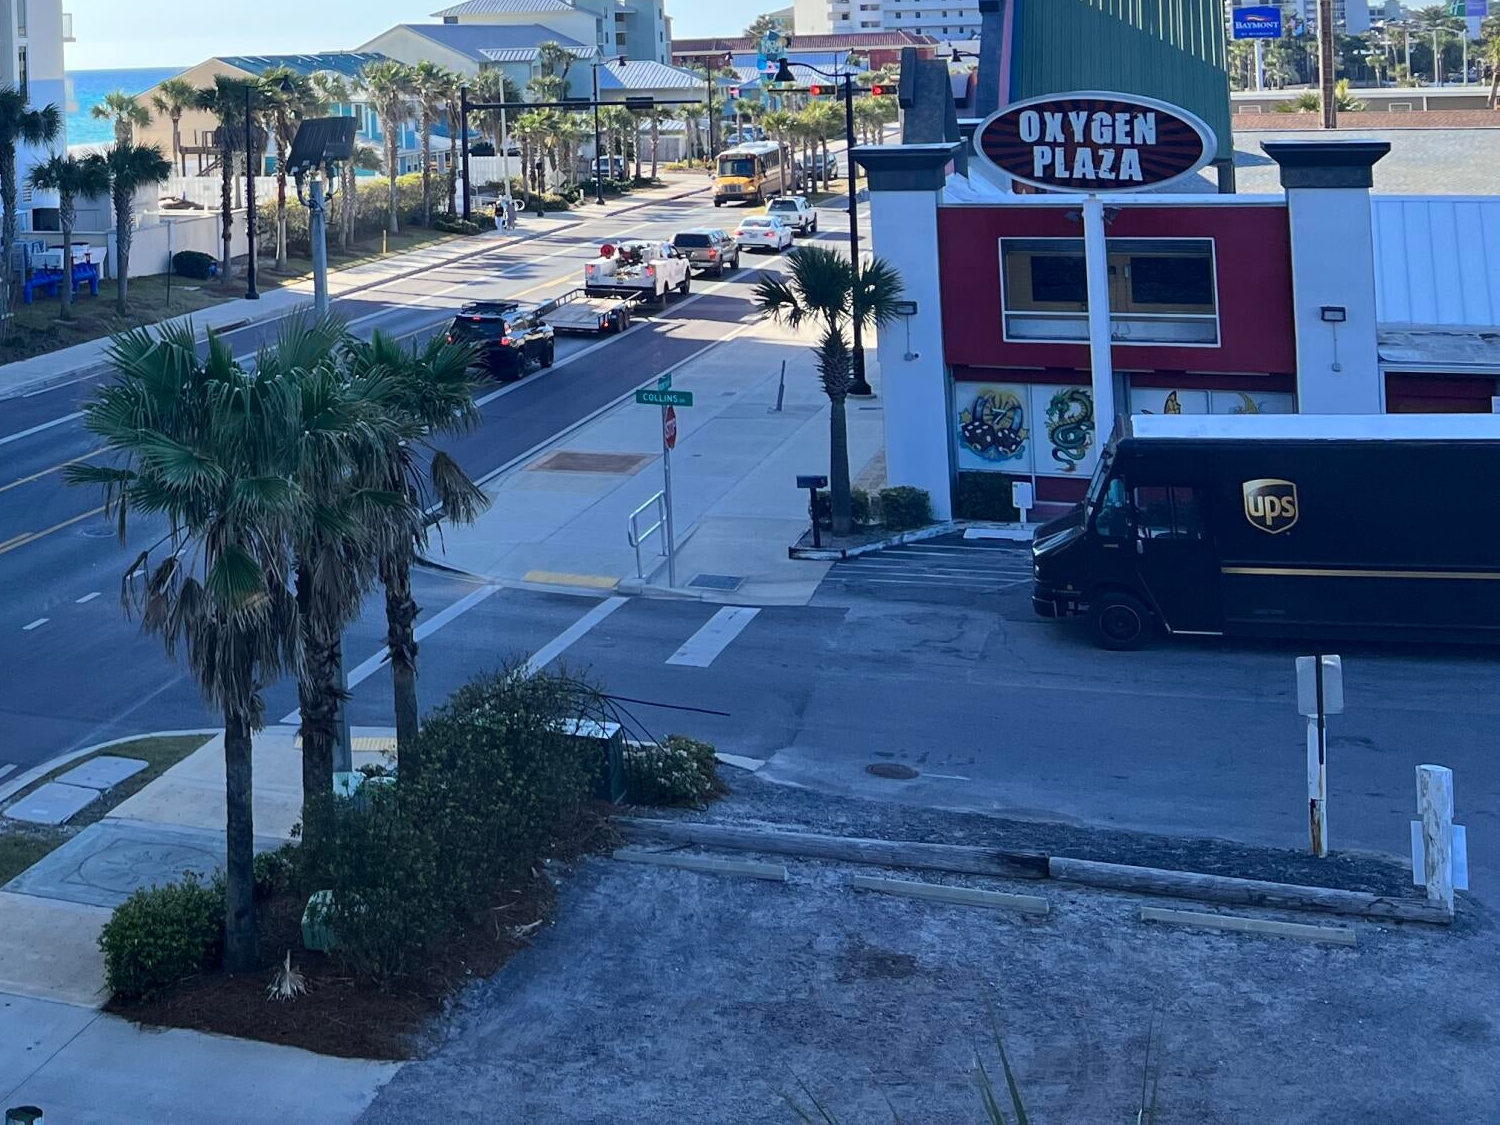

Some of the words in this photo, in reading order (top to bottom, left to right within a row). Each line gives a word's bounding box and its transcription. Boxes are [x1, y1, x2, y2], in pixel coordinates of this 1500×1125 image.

[1235, 21, 1280, 30] BAYMONT
[1018, 109, 1157, 146] OXYGEN
[1032, 144, 1144, 182] PLAZA
[642, 393, 678, 403] COLLINS
[1247, 495, 1296, 526] ups
